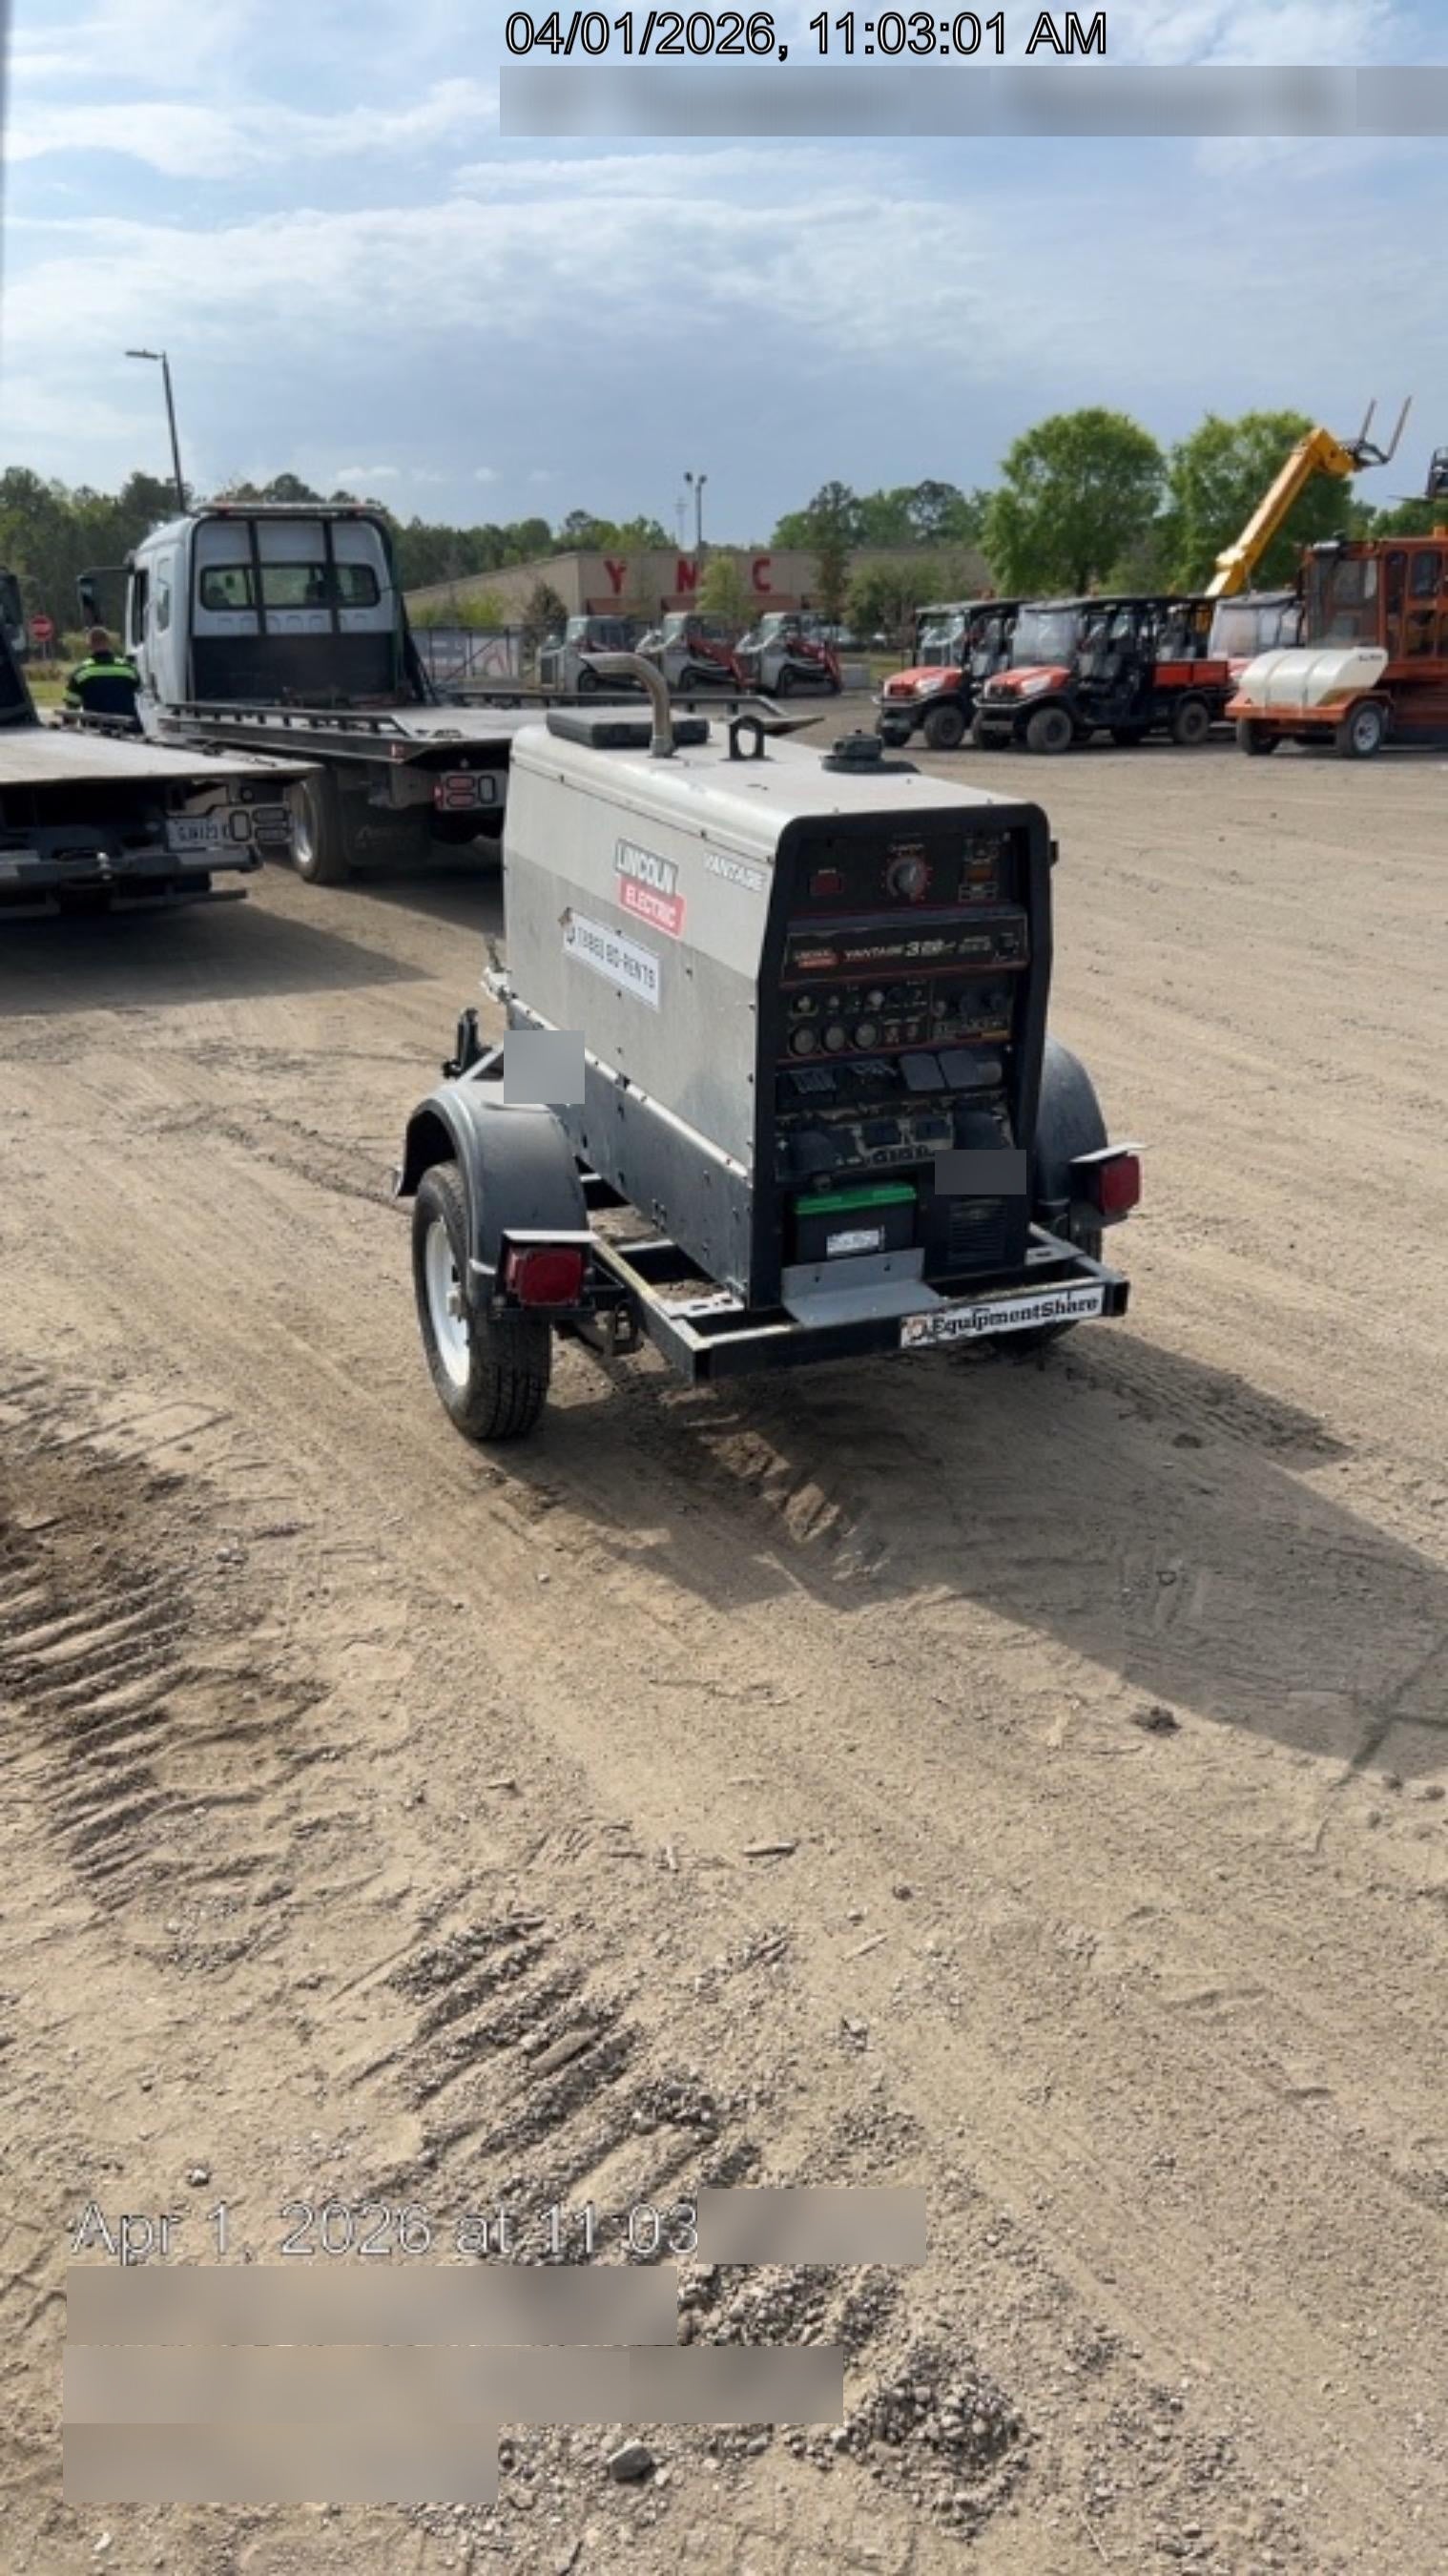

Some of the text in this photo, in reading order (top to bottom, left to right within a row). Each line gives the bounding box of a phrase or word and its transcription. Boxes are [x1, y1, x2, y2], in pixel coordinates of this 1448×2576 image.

[616, 841, 675, 895] LINCOLN
[625, 883, 677, 928] ELECTRIC
[931, 1293, 1099, 1336] EquipmentShare
